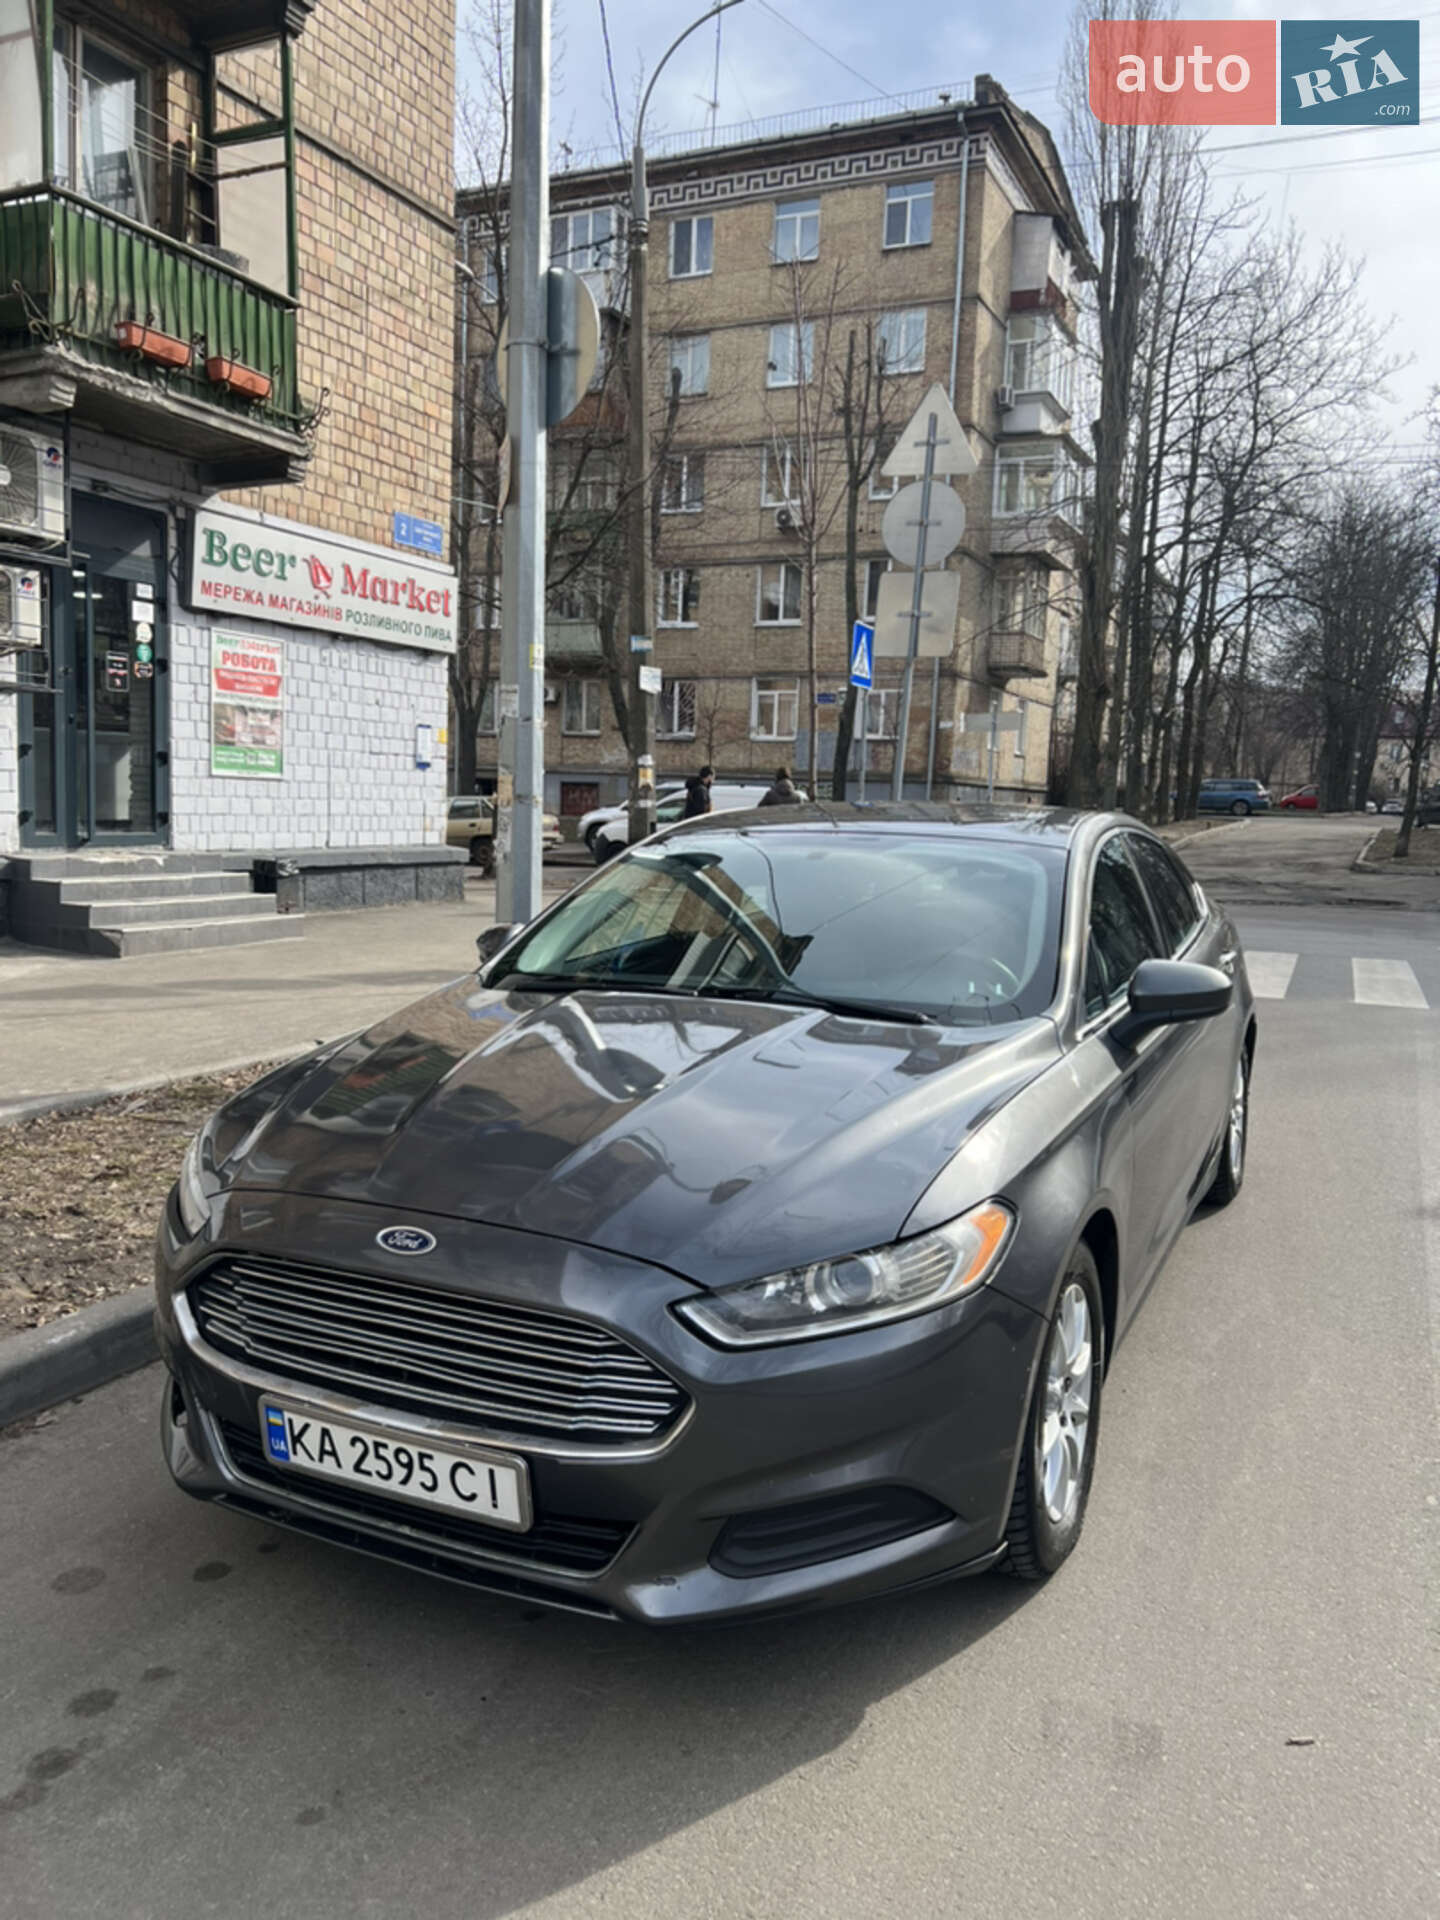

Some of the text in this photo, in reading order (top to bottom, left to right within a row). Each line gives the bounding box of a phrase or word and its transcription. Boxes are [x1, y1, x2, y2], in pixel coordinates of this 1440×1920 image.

[201, 527, 452, 617] Beer Market
[201, 580, 453, 642] МЕРЕЖА МАГАЗИНІВ РОЗЛИВНОГО ПИВА
[222, 649, 277, 672] РОБОТА
[387, 1231, 423, 1249] Ford
[272, 1439, 287, 1452] UA
[288, 1417, 342, 1469] KA
[350, 1436, 439, 1493] 2595
